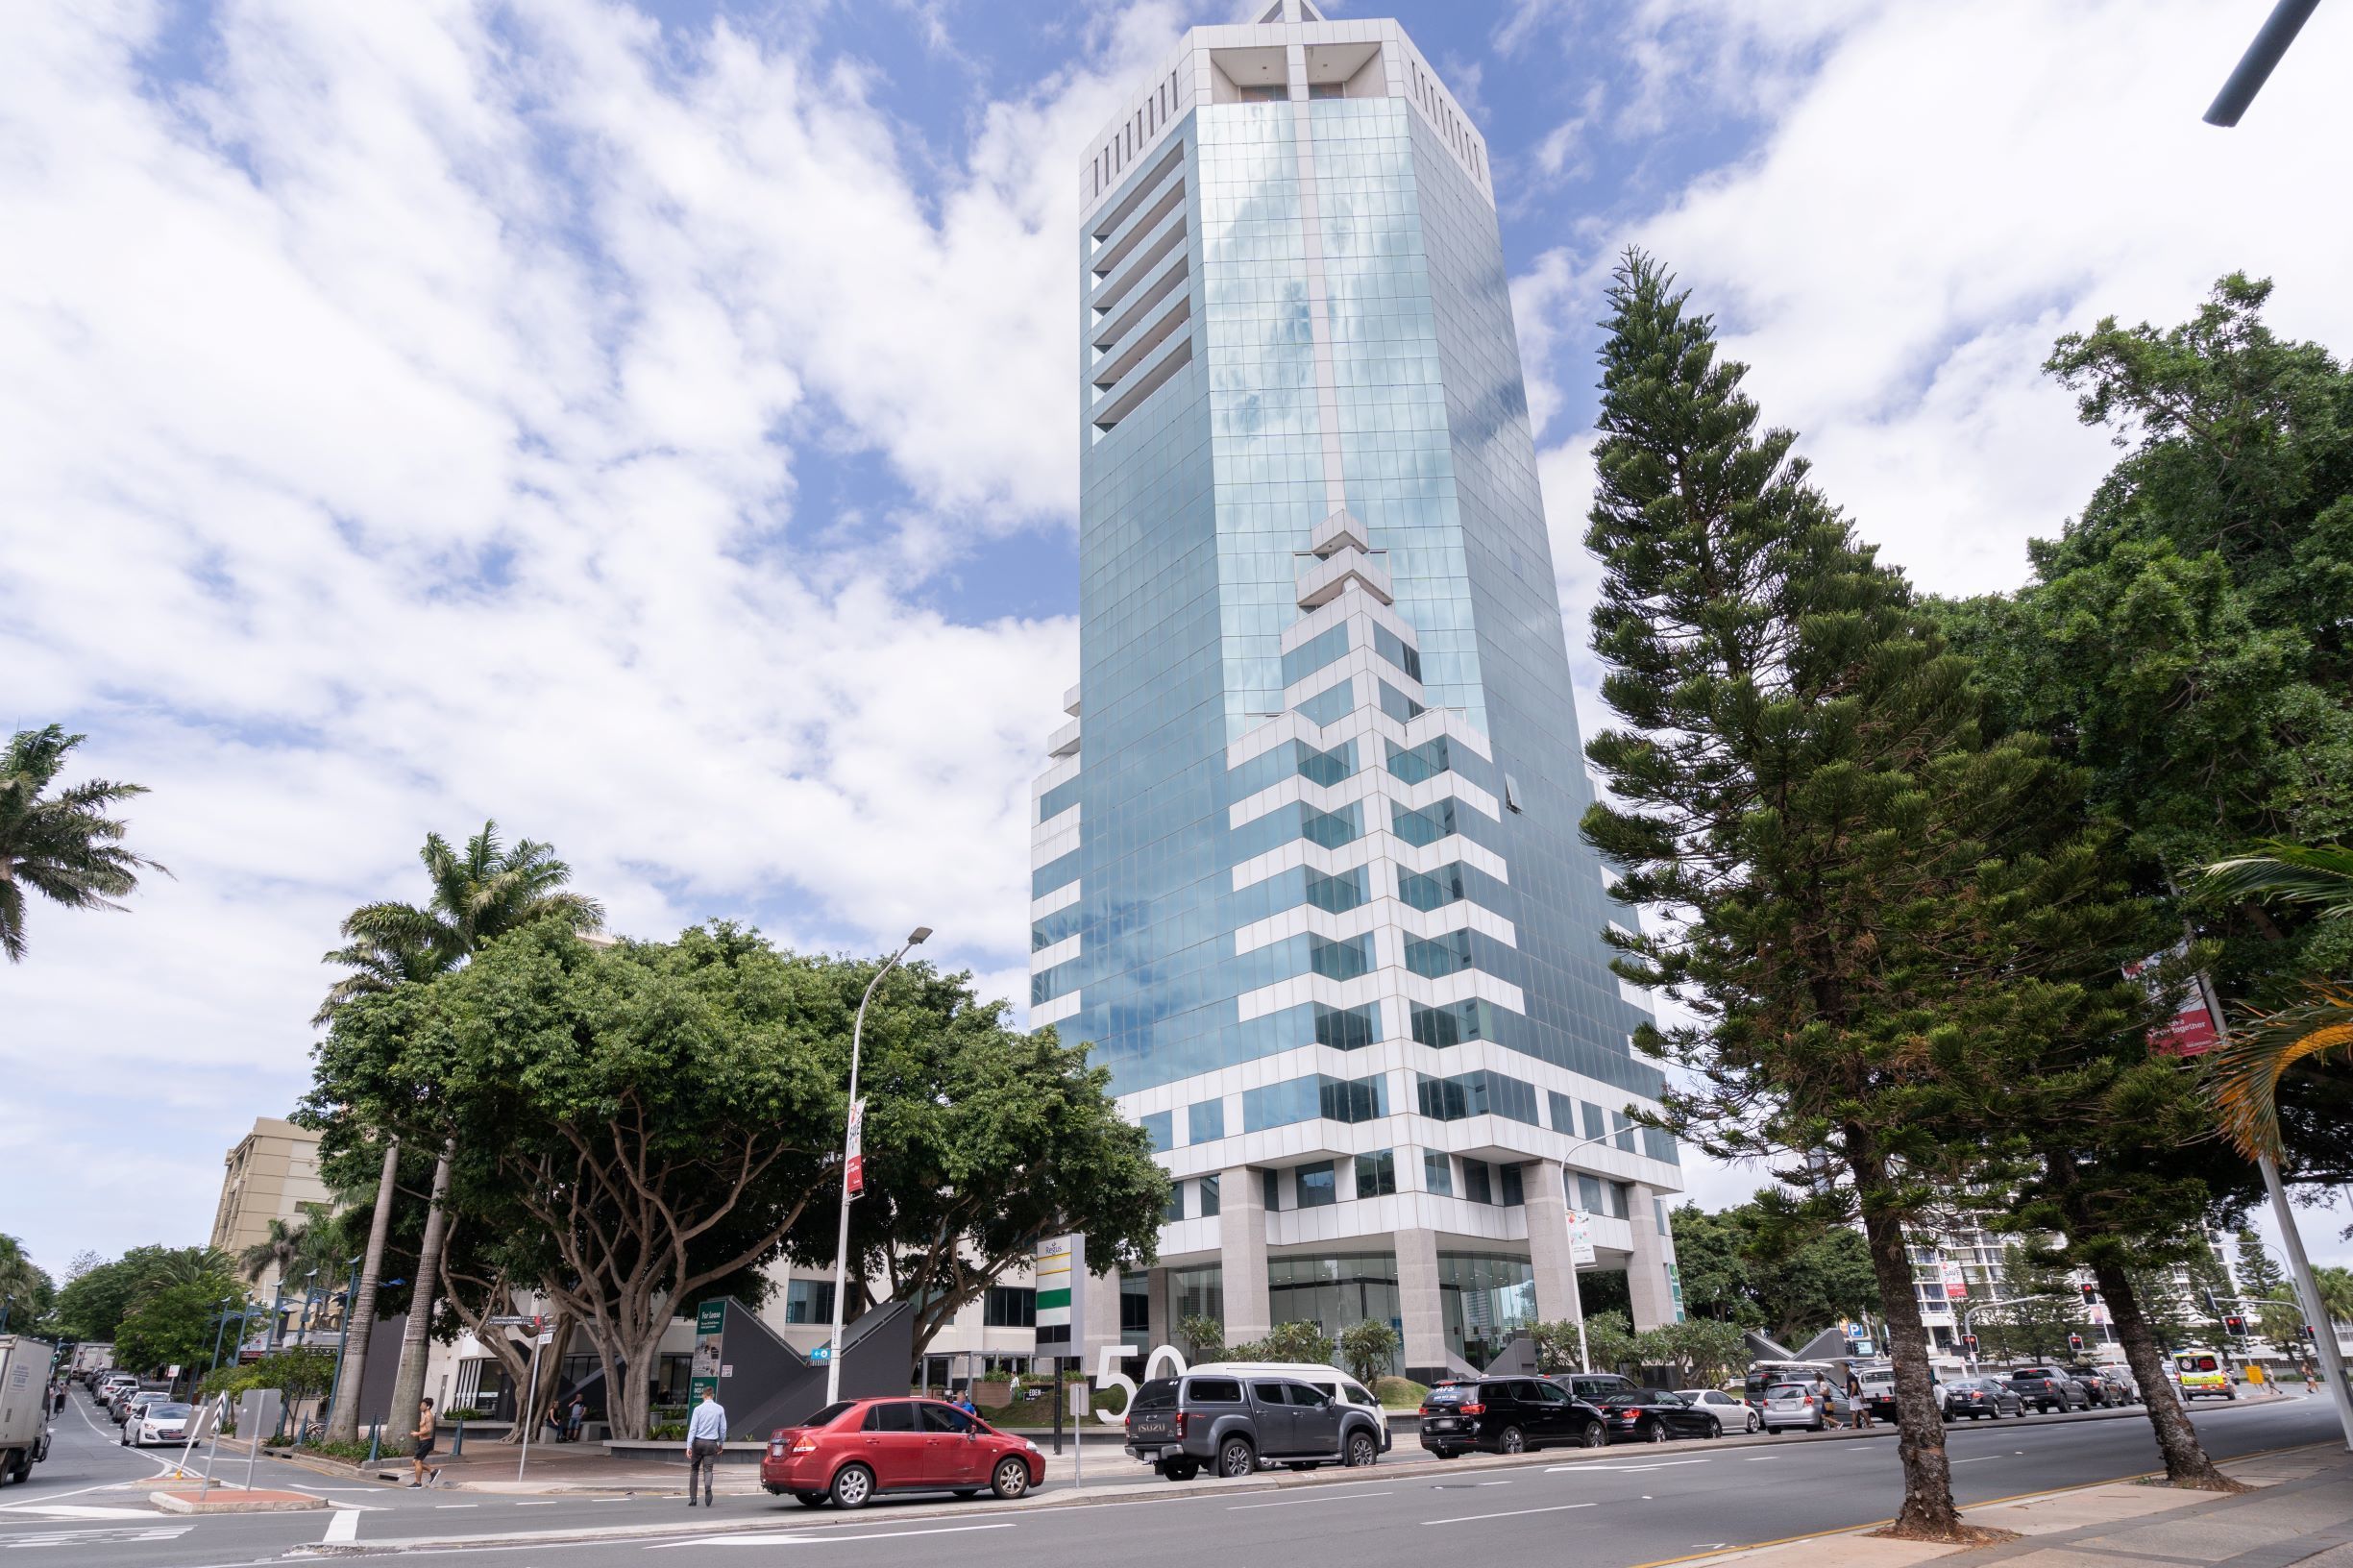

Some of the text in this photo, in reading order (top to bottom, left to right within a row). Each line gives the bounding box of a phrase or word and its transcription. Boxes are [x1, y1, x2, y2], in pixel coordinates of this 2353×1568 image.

[1045, 1245, 1063, 1256] Regus
[2184, 1376, 2218, 1384] Ambulance
[1138, 1422, 1165, 1433] ISUZU
